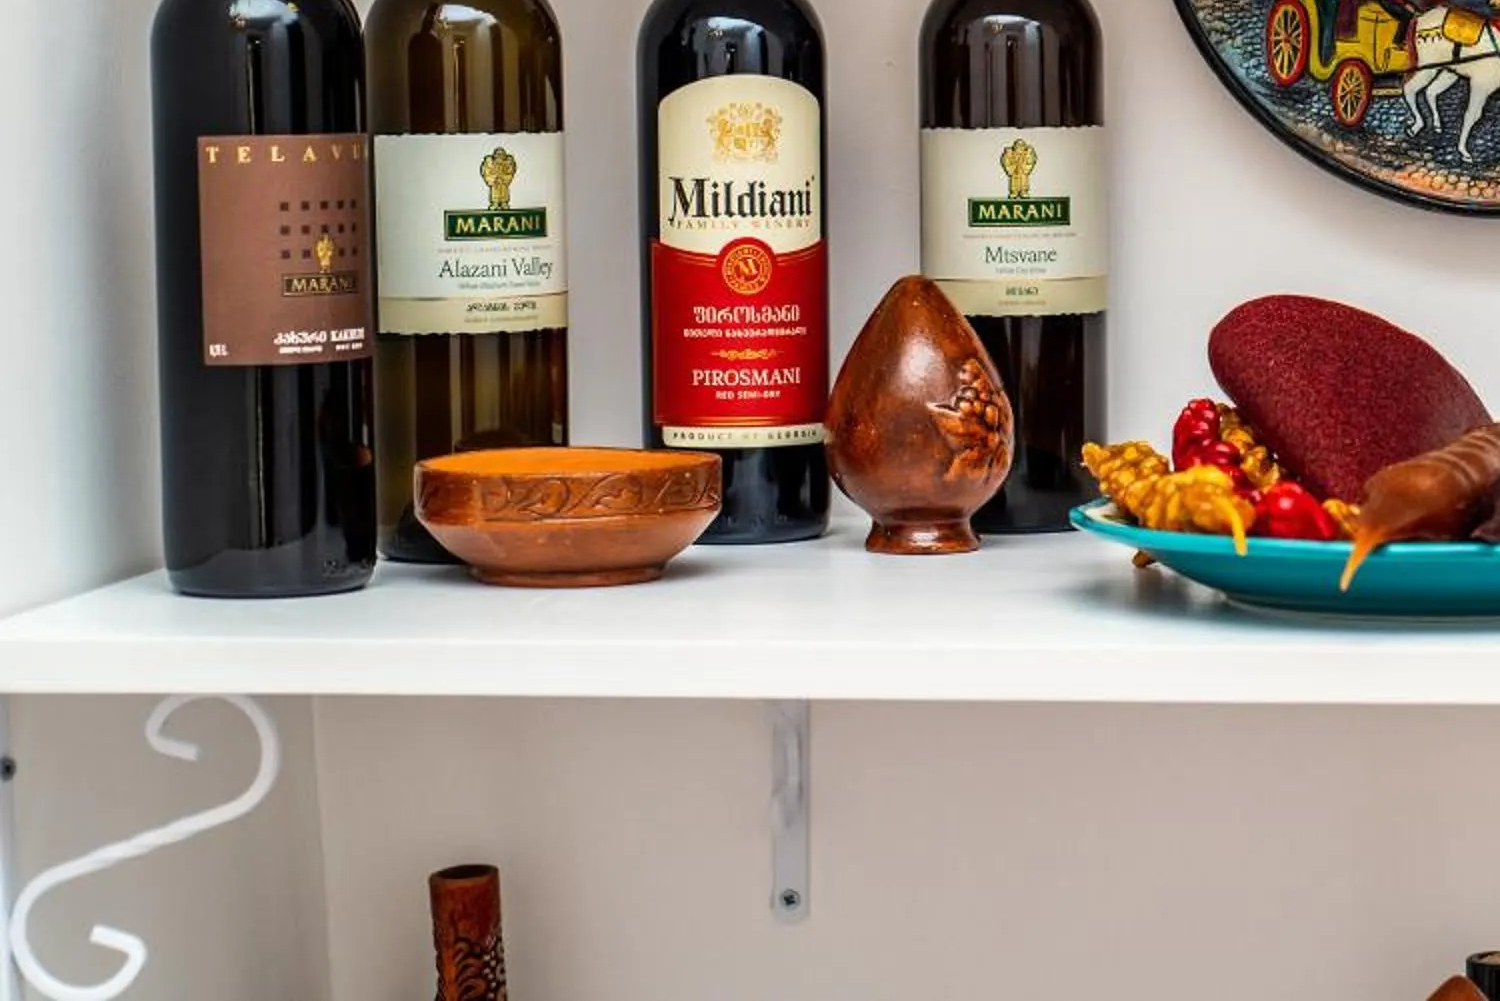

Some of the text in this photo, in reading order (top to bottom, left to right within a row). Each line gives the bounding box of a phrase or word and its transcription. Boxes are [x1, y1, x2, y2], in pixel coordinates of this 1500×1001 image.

[668, 175, 813, 223] Mildiani
[978, 203, 1062, 222] MARANI
[455, 214, 541, 235] MARANI
[985, 246, 1057, 265] Mtsvane
[438, 256, 554, 279] Alazani Valley
[692, 366, 800, 387] PIROSMANI
